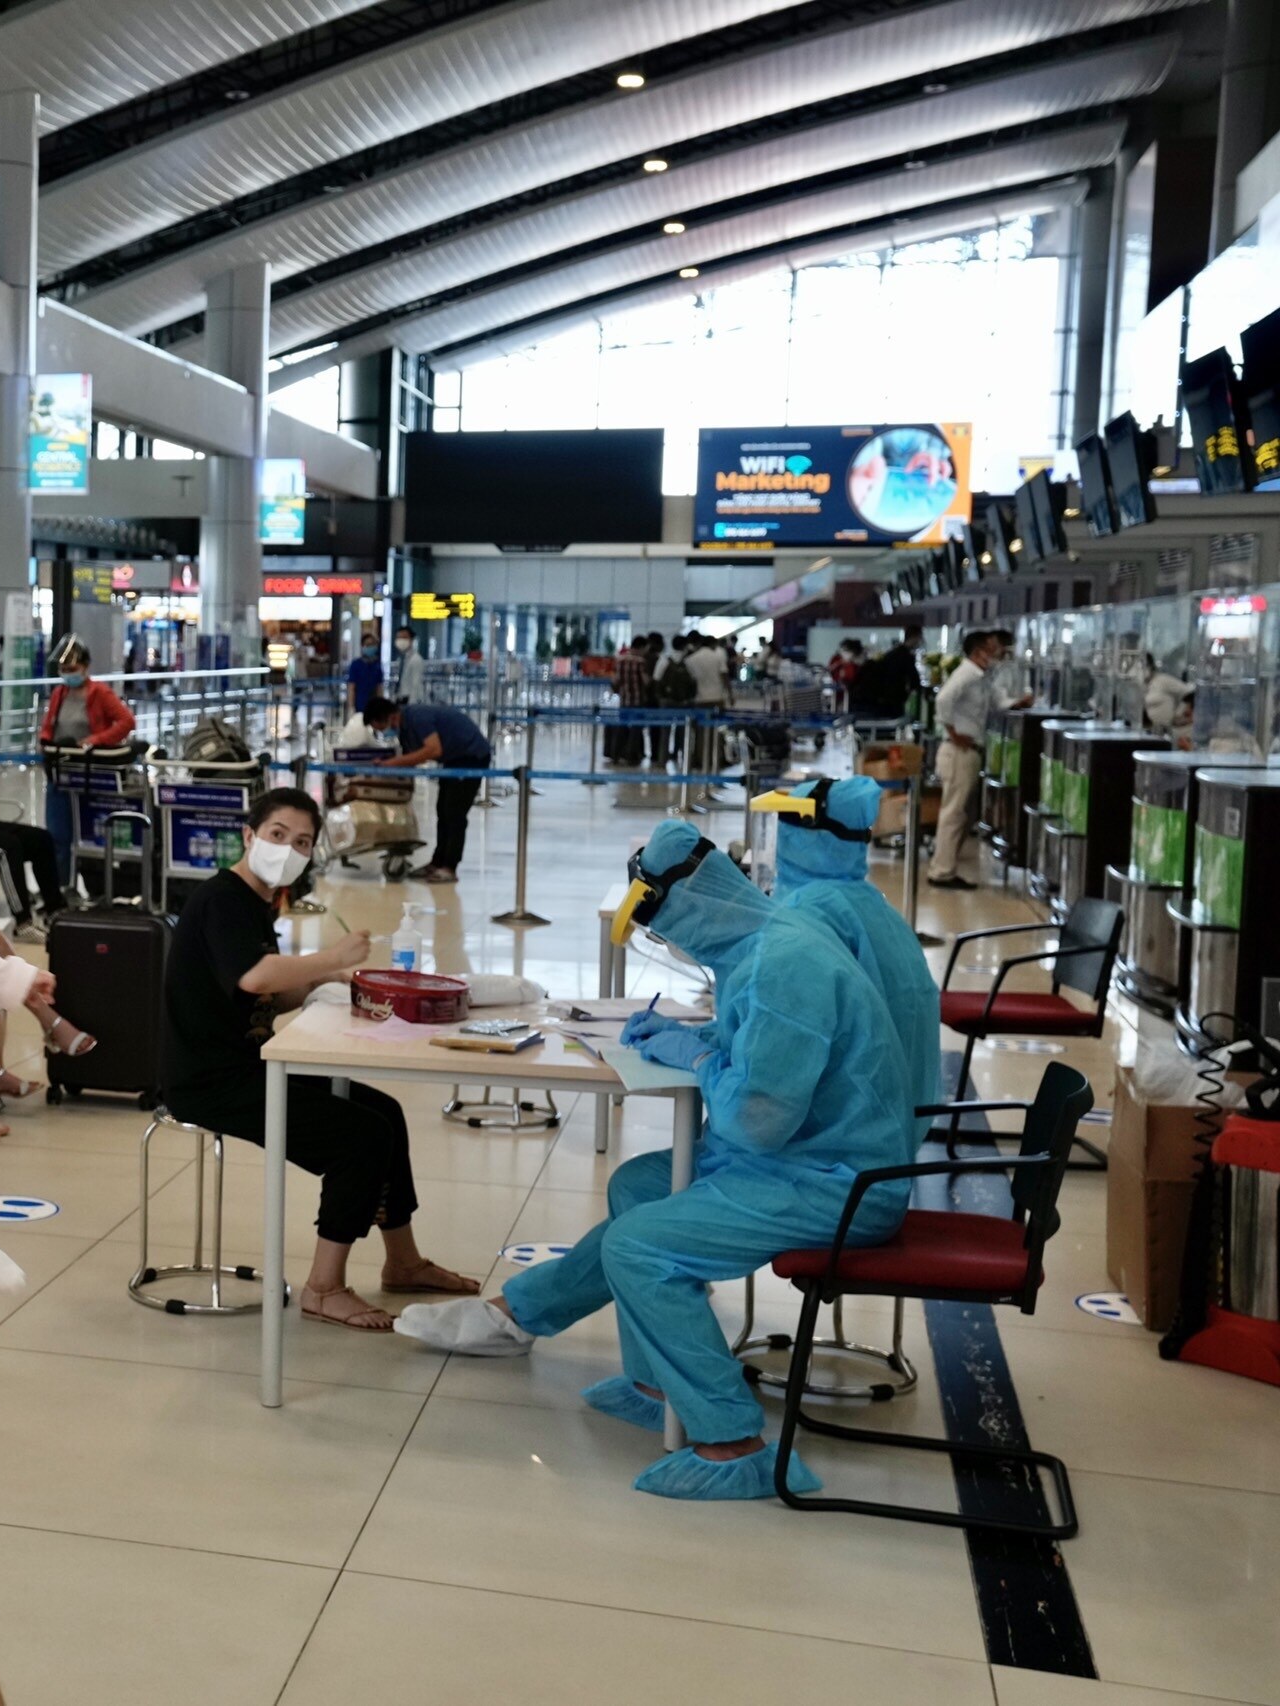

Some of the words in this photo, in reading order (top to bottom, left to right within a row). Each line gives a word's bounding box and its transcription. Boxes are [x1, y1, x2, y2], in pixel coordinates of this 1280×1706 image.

[716, 471, 831, 494] Marketing
[265, 578, 304, 594] FOOD
[317, 578, 363, 594] DRINK
